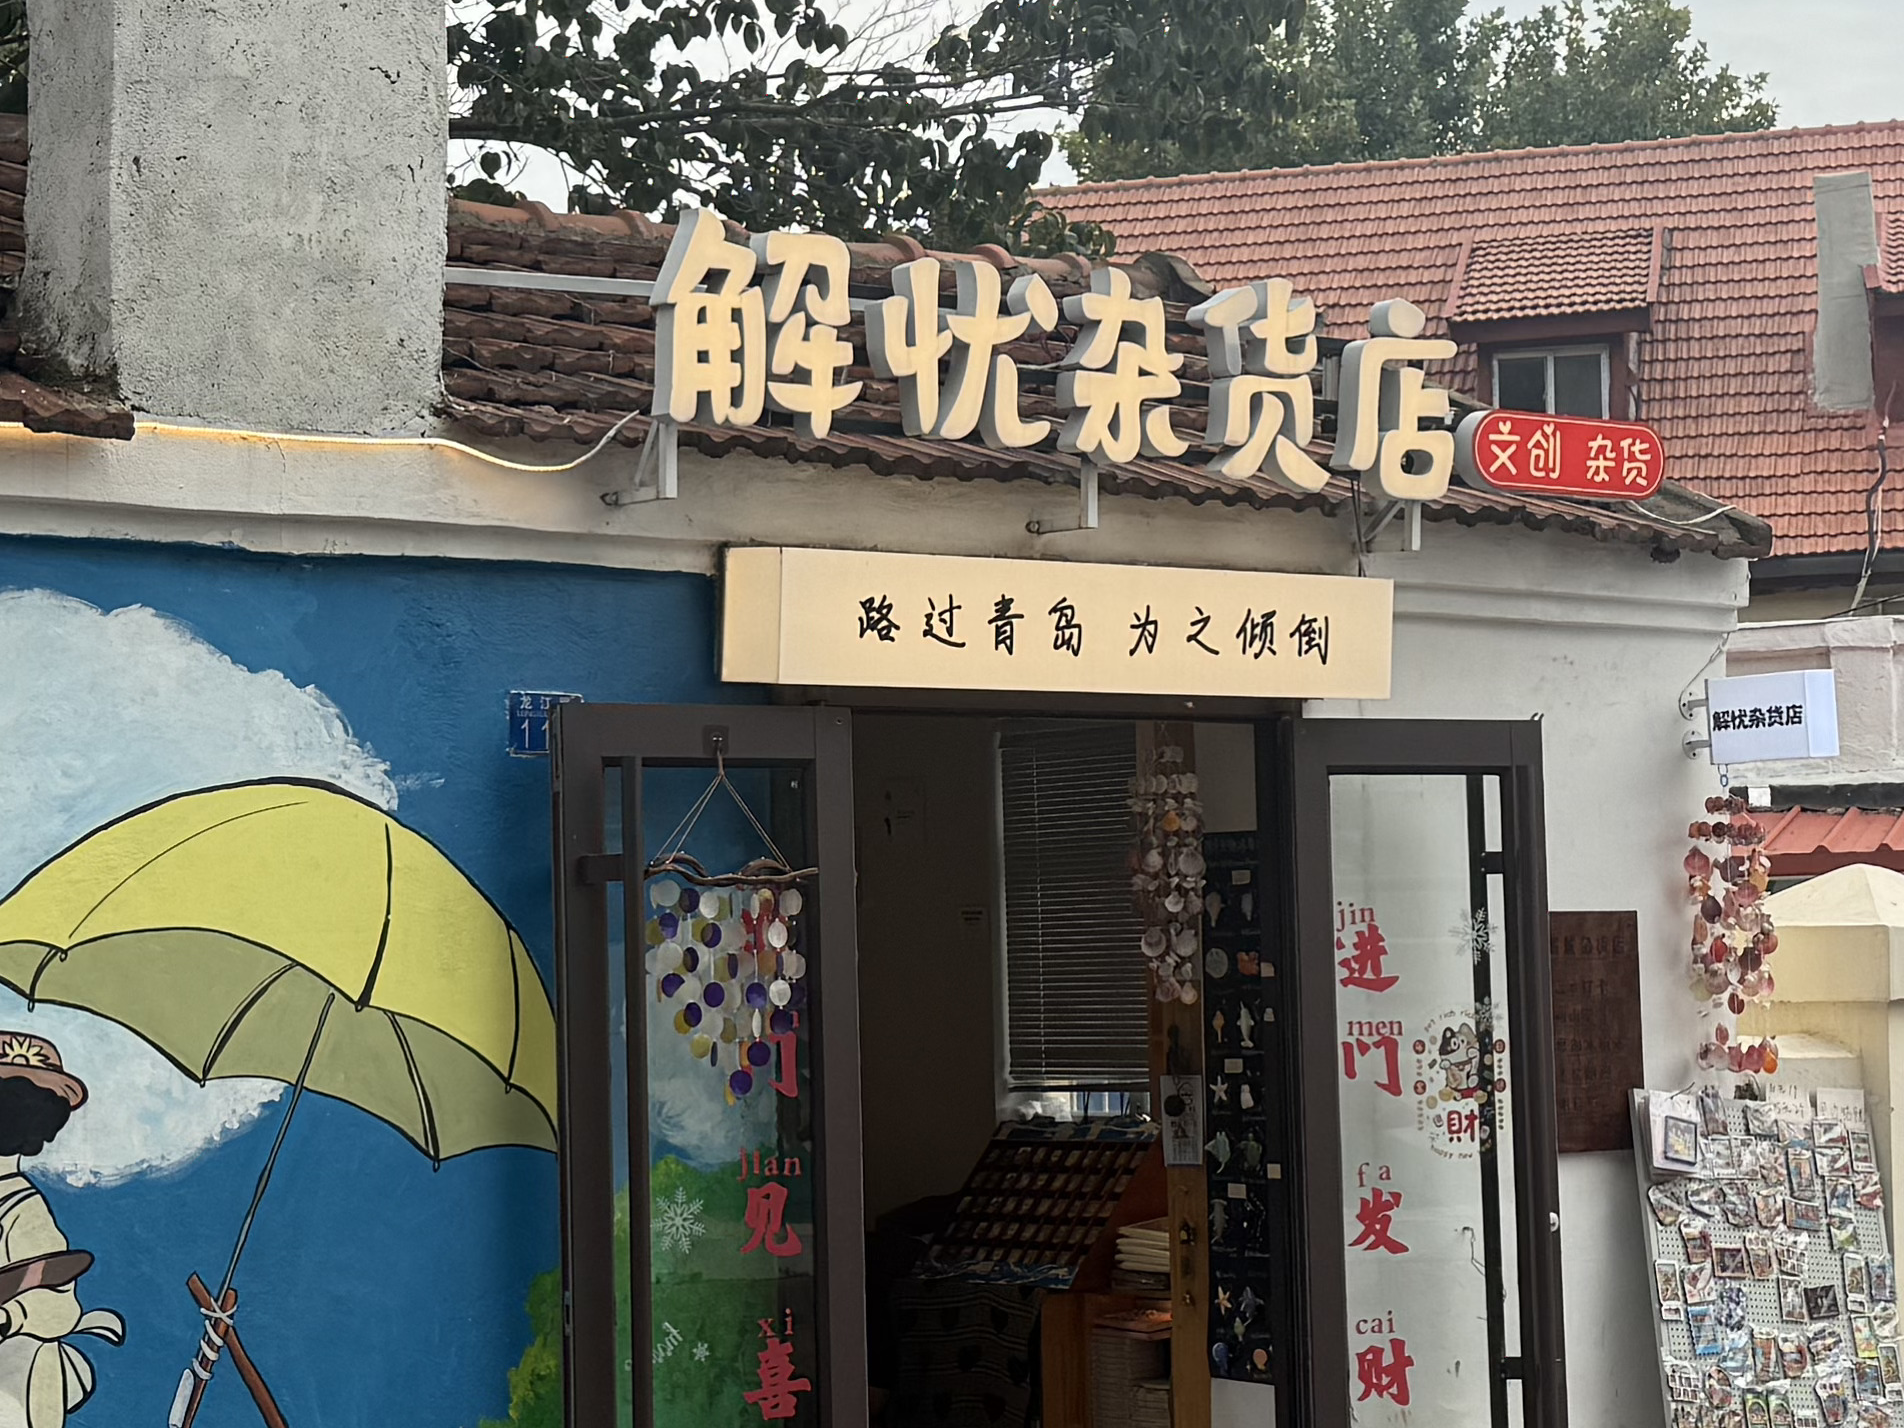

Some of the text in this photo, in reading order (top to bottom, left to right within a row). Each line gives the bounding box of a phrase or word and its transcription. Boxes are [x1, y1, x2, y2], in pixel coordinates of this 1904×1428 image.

[666, 208, 1458, 501] 解忧杂货店
[1488, 420, 1652, 487] 文创 杂货
[858, 593, 1330, 666] 路过青岛 为之倾倒
[1712, 704, 1803, 732] 解忧杂货店
[1336, 901, 1376, 932] jin
[1336, 923, 1400, 993] 进
[1347, 1019, 1403, 1037] men
[1341, 1036, 1403, 1097] 门
[737, 1146, 802, 1183] jian
[1357, 1162, 1392, 1188] fa
[739, 1181, 803, 1257] 见
[1348, 1187, 1410, 1255] 发
[757, 1307, 794, 1338] xi
[1355, 1310, 1396, 1335] cai
[742, 1337, 813, 1421] 喜
[1355, 1338, 1416, 1407] 财
